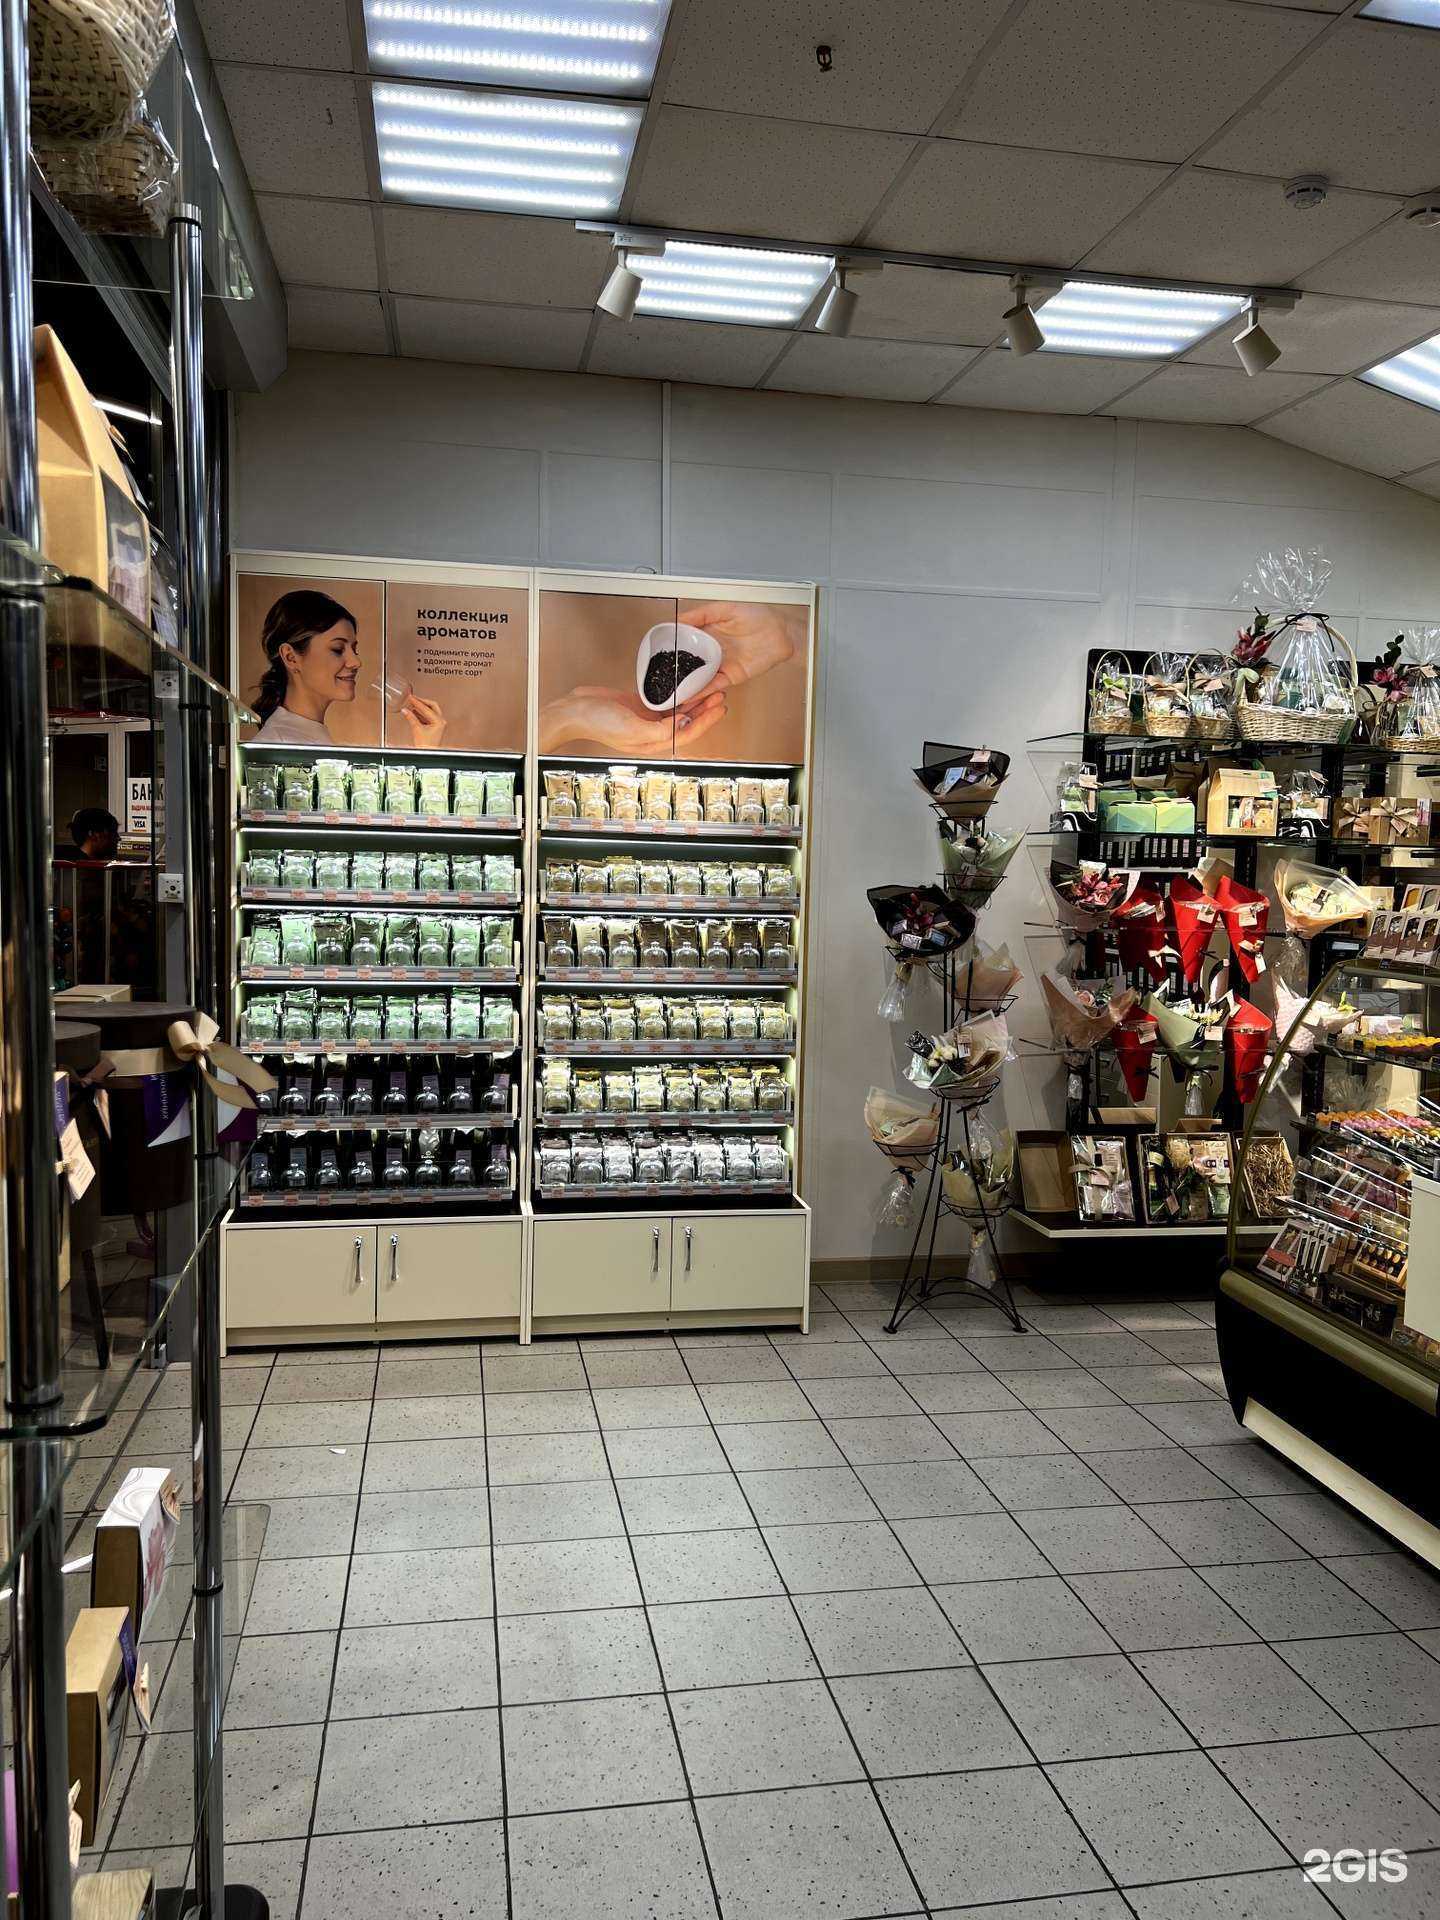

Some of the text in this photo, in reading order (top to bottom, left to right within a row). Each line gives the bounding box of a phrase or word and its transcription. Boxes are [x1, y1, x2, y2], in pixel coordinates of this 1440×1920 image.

[417, 608, 509, 624] коллекция
[417, 626, 497, 640] ароматов
[423, 648, 495, 659] поднимите купол
[423, 658, 492, 668] вдохните аромат
[423, 667, 483, 677] выберите сорт
